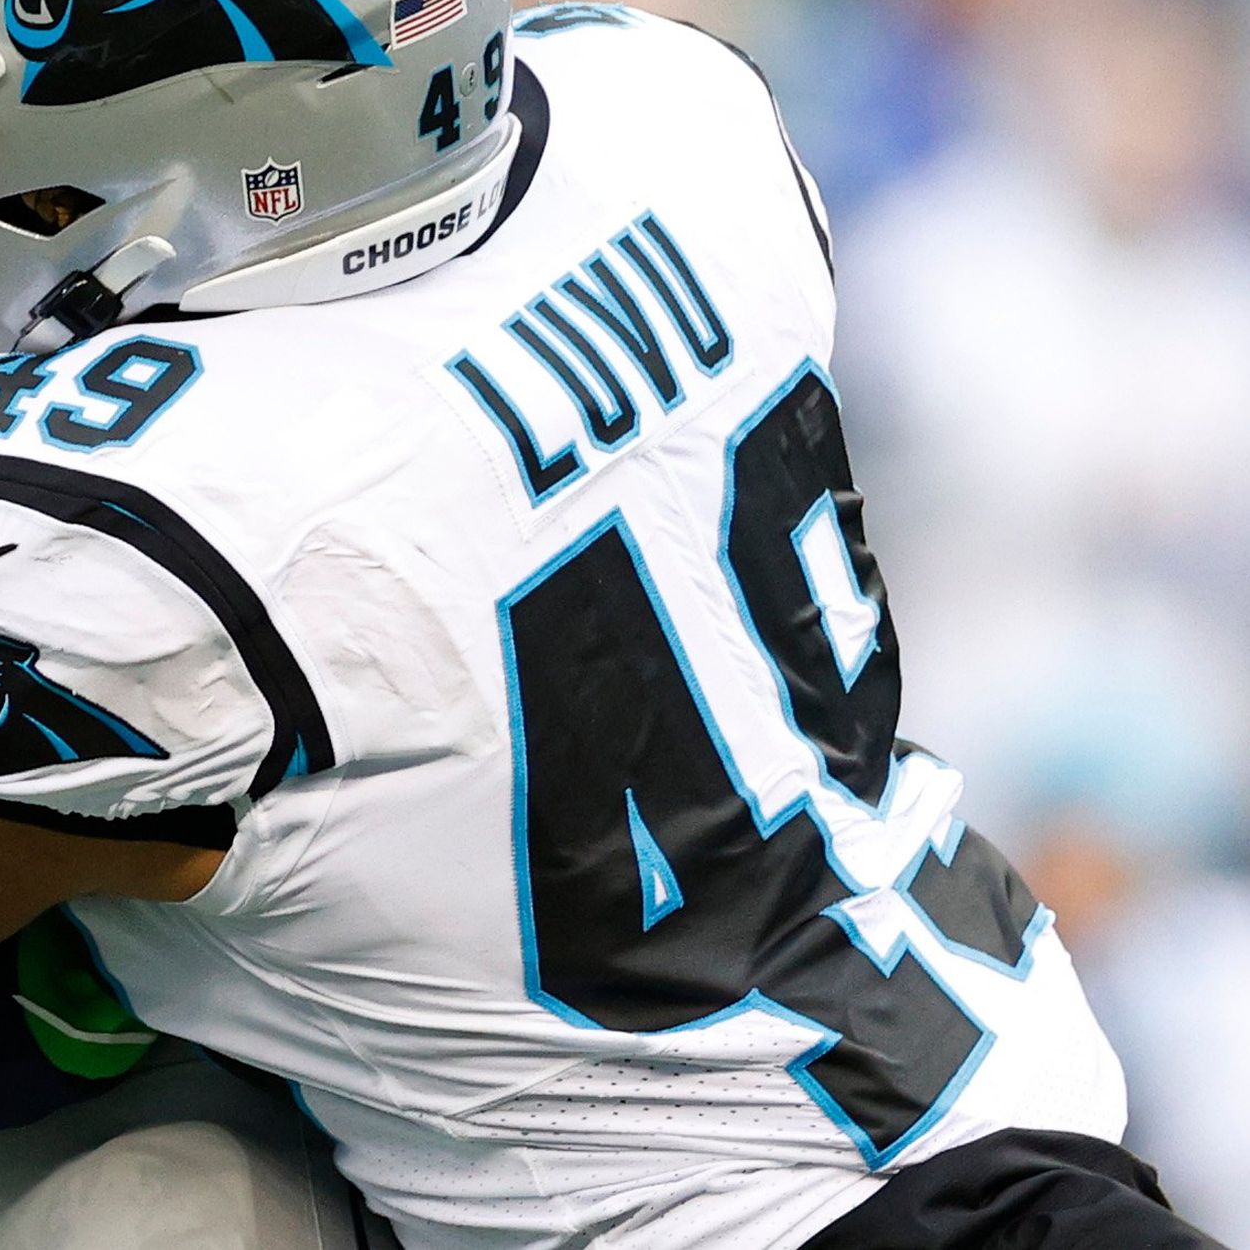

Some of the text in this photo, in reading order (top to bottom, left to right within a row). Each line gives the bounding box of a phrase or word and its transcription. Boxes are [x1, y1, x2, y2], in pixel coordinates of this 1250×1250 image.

[417, 30, 504, 153] 49
[252, 187, 297, 215] NFL
[342, 200, 473, 276] CHOOSE
[444, 209, 733, 507] LUVU
[495, 357, 1054, 1172] 49
